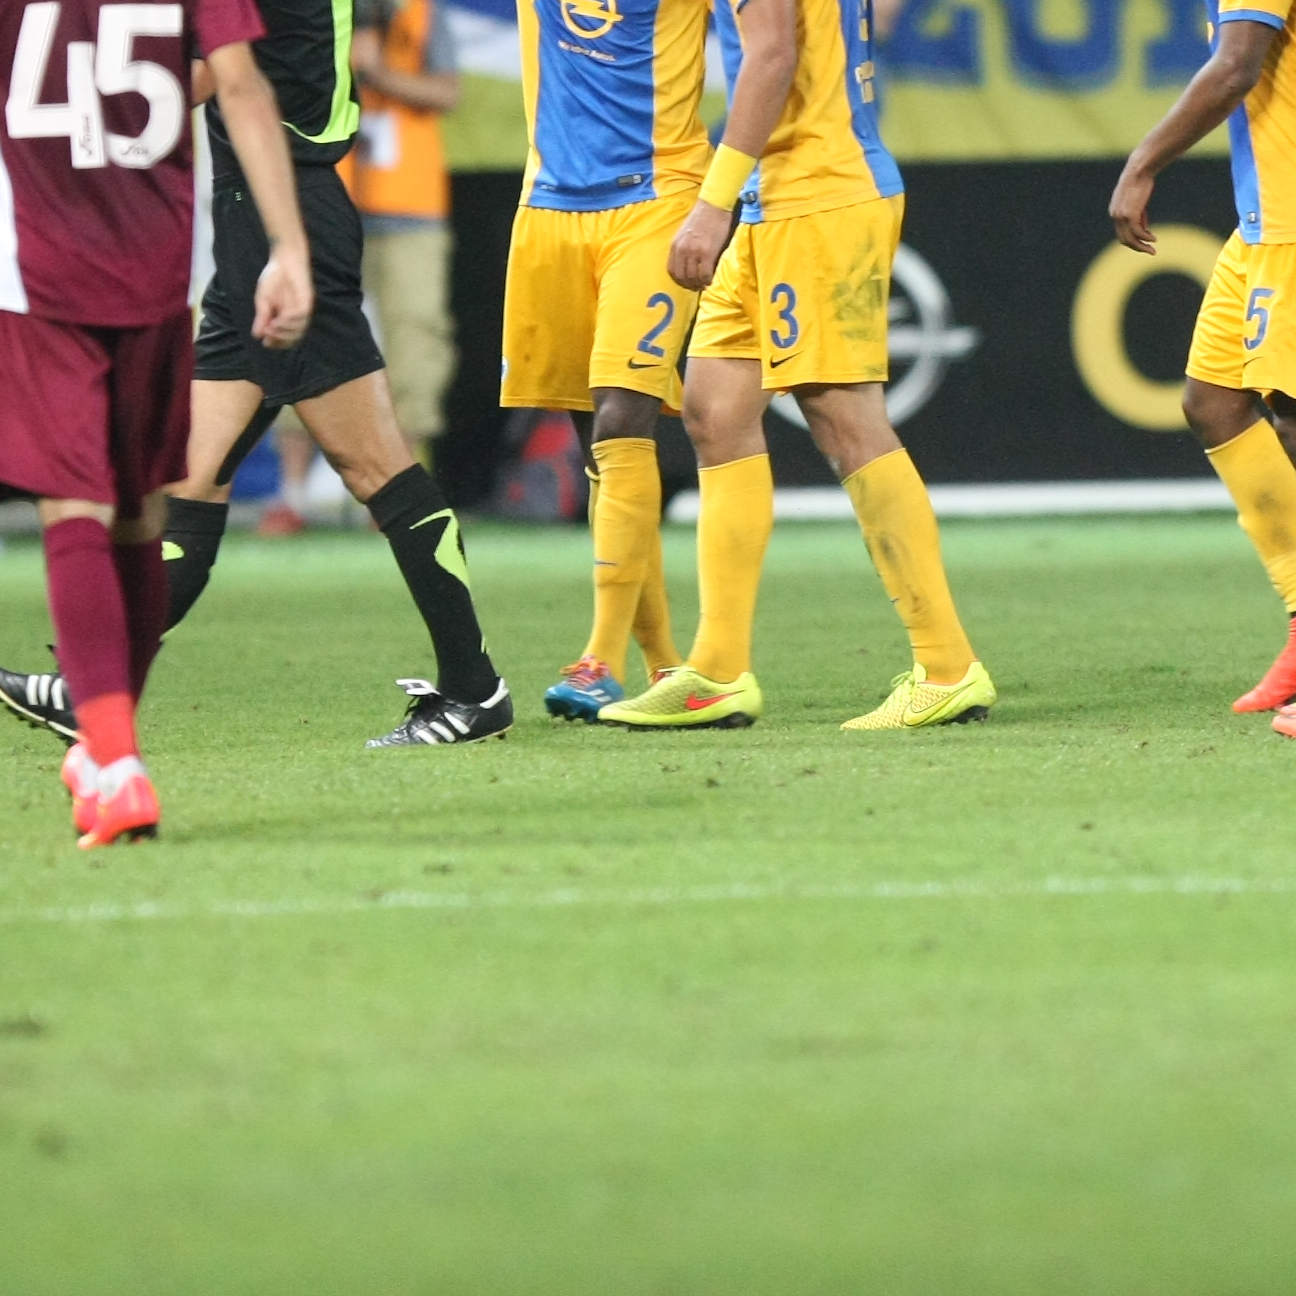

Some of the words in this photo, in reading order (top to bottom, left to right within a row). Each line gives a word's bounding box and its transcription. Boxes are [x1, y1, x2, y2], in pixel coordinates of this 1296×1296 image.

[4, 0, 185, 170] 45
[636, 291, 675, 359] 2
[769, 281, 800, 350] 3
[1243, 287, 1276, 352] 5
